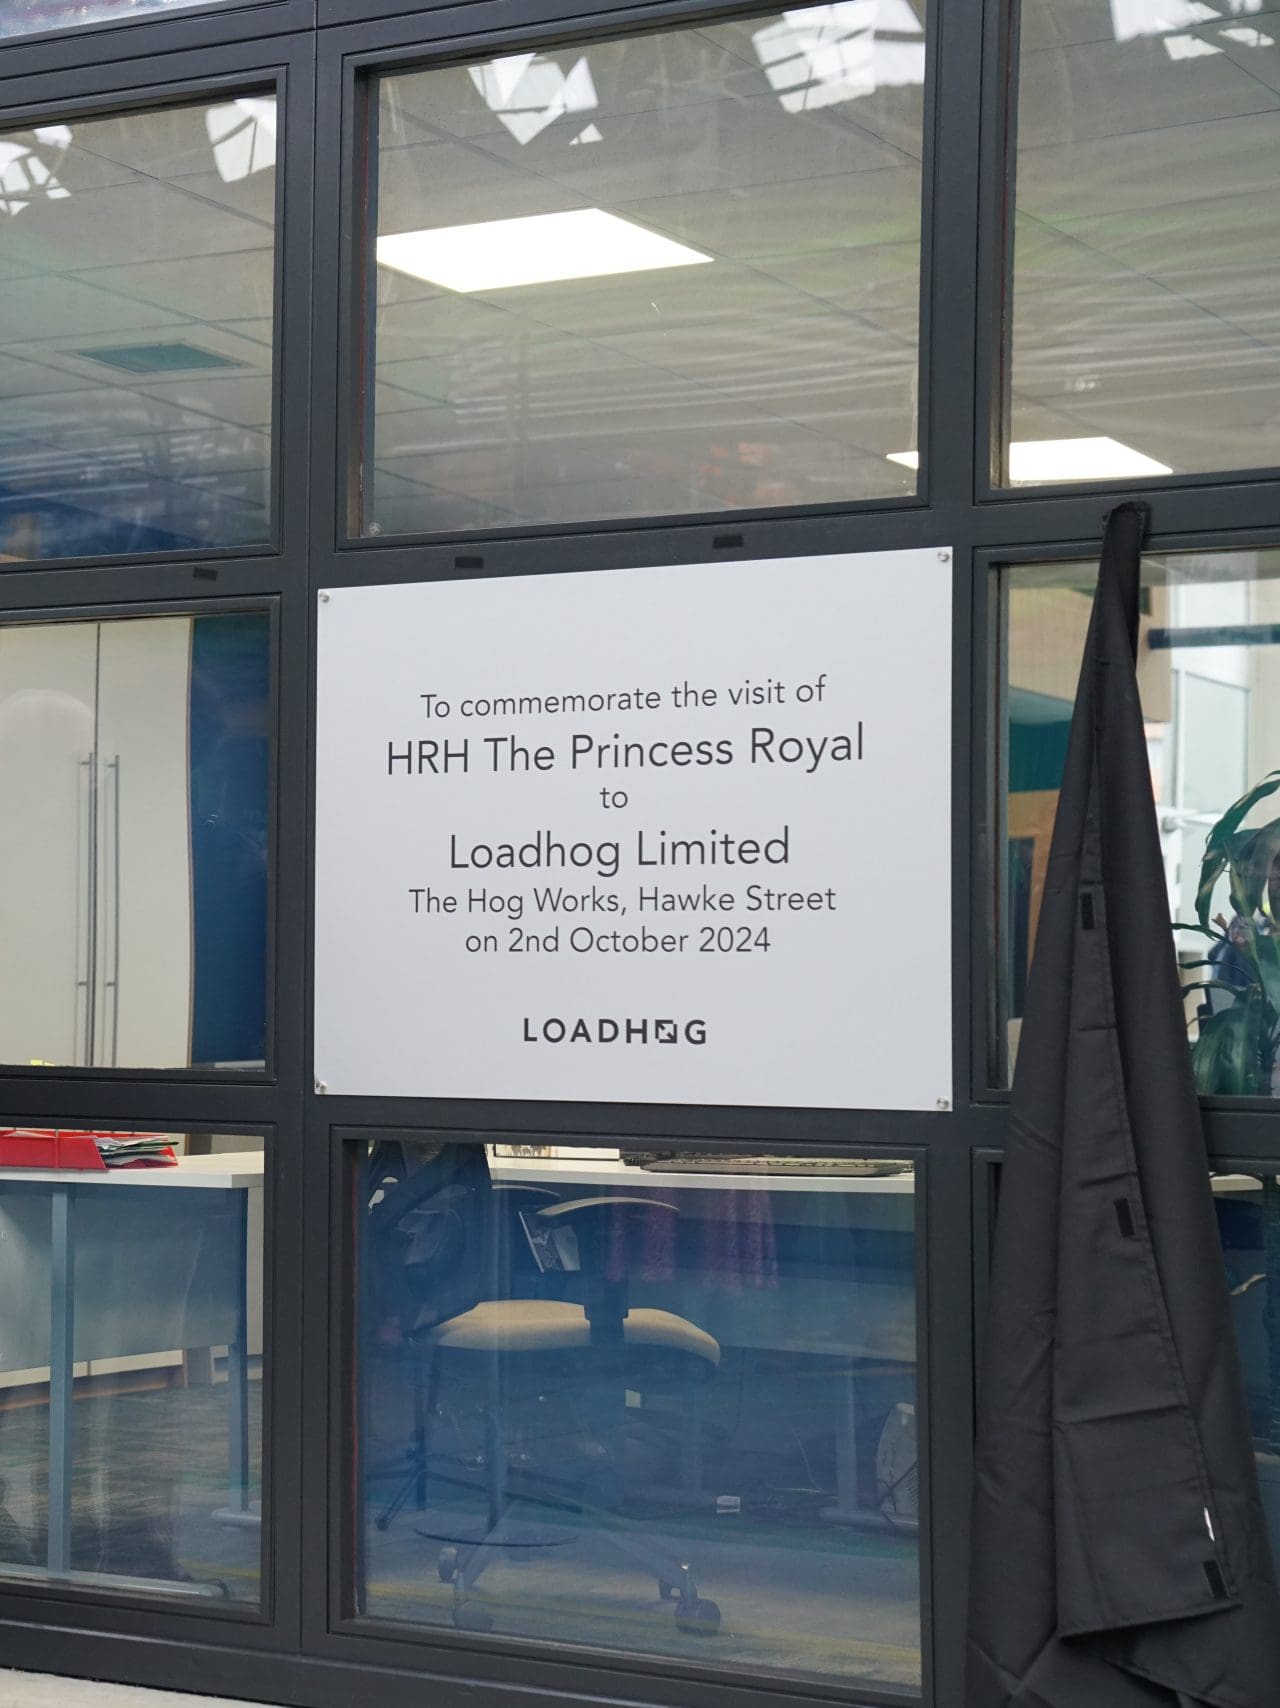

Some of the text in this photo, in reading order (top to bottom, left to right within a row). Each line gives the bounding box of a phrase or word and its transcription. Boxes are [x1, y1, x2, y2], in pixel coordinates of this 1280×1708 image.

[419, 673, 828, 719] To commemorate the visit of
[388, 720, 864, 776] HRH The Princess Royal
[599, 786, 629, 809] to
[450, 824, 790, 878] Loadhog Limited
[408, 883, 837, 921] The Hog Works, Hawke Street
[464, 925, 772, 953] on 2nd October 2024
